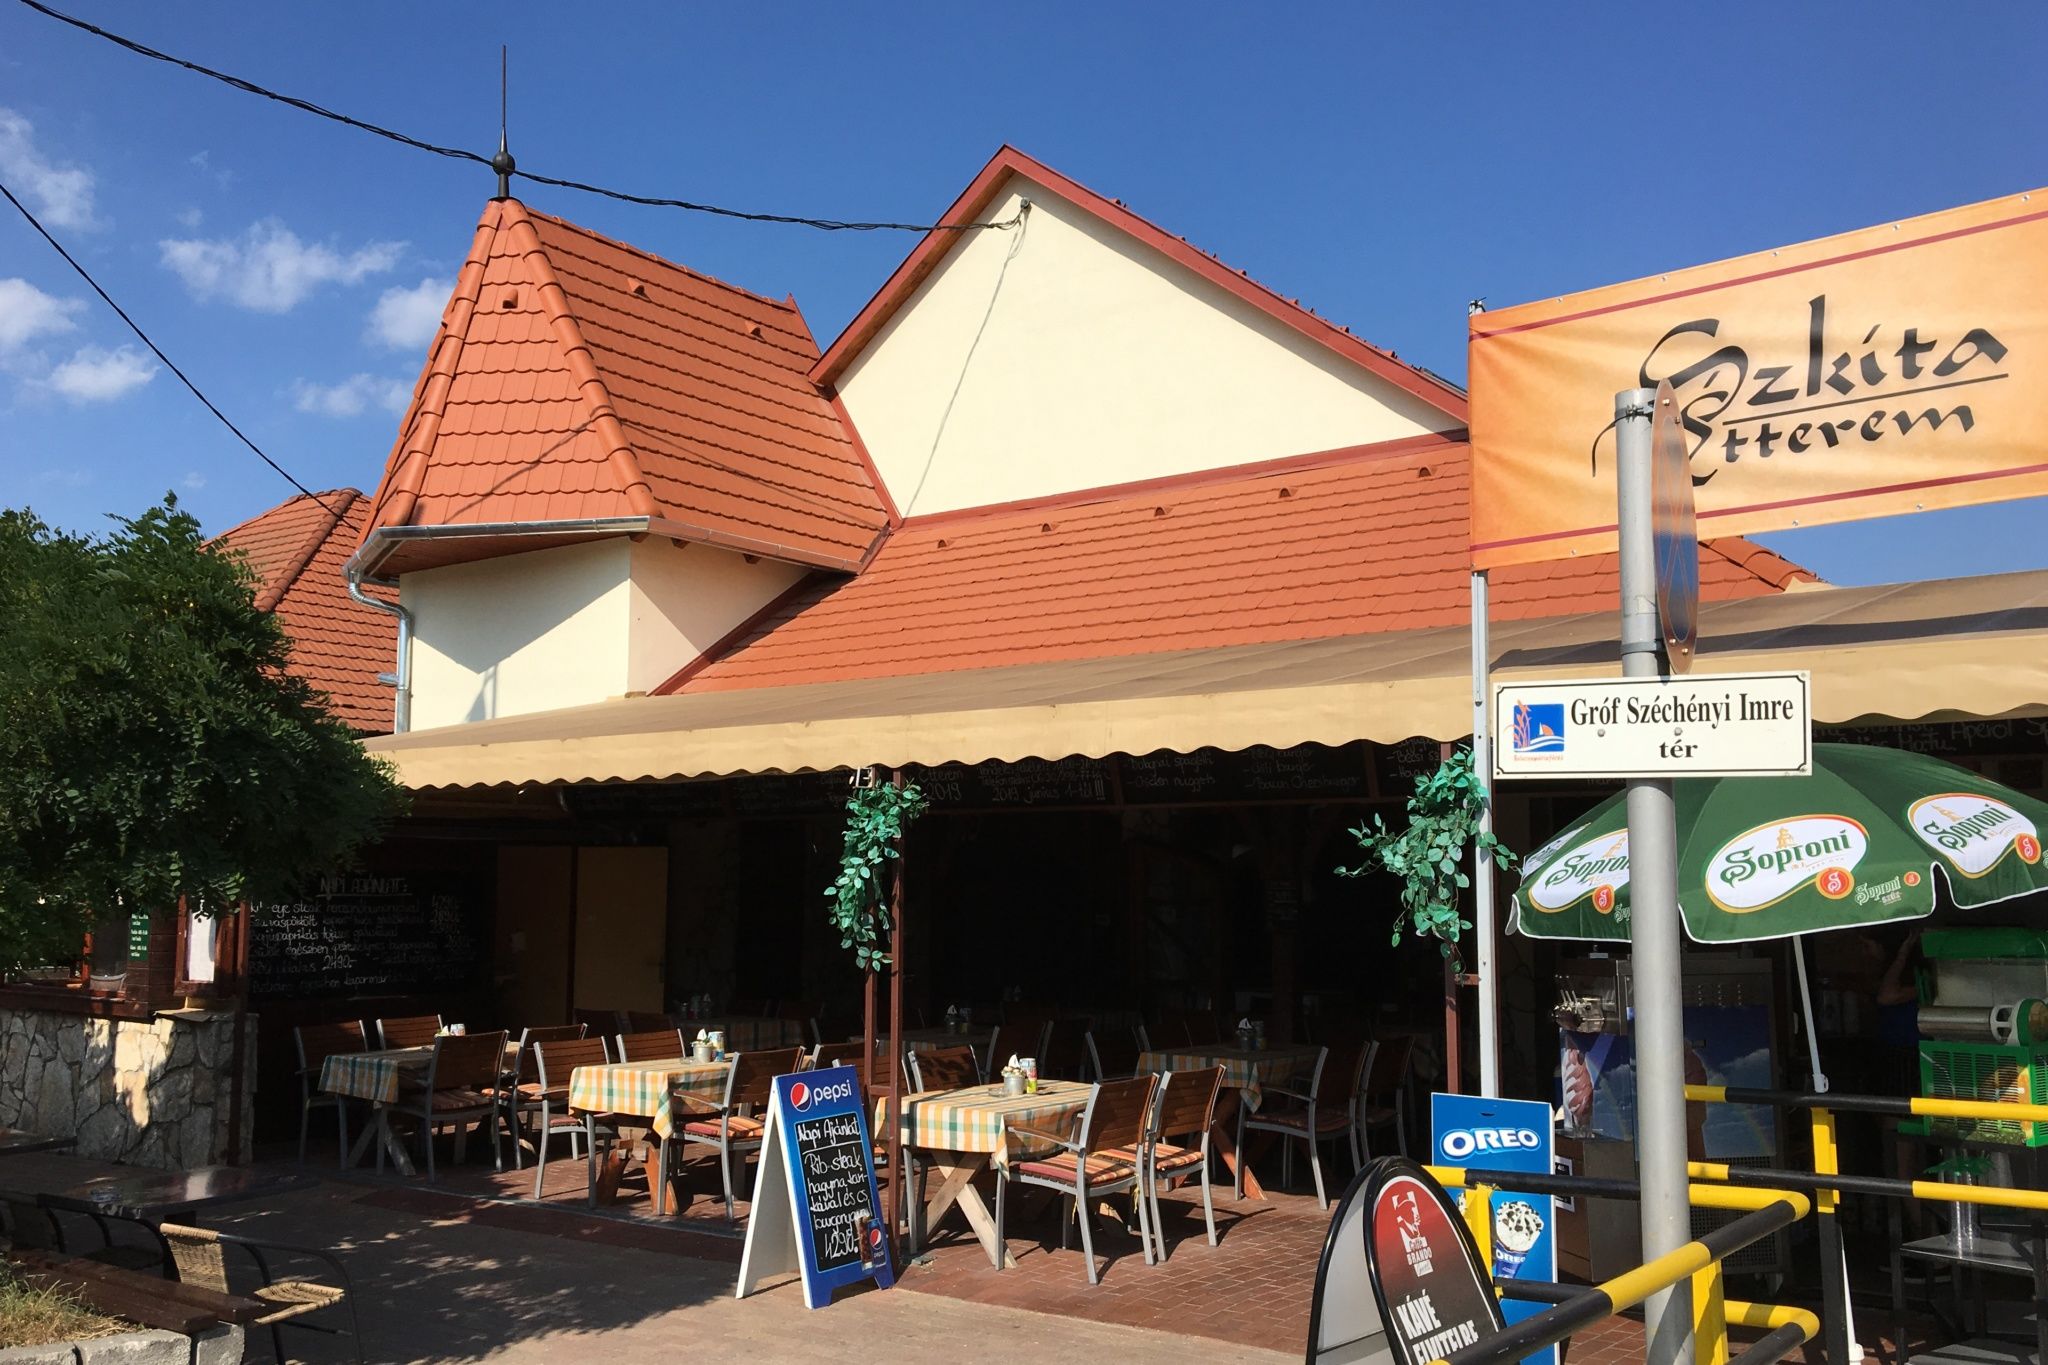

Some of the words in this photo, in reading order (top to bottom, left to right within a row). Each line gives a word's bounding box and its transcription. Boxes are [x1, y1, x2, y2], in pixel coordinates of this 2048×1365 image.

[1639, 294, 2008, 421] Szkíta
[1571, 696, 1620, 726] Gróf
[1627, 693, 1730, 729] Széchényi
[1739, 692, 1794, 721] Imre
[1659, 739, 1698, 759] tér
[1923, 804, 2012, 854] Soproni
[1544, 852, 1630, 891] Sopro
[1720, 829, 1852, 888] Soproni
[813, 1079, 852, 1106] pepsi
[797, 1122, 821, 1148] Napi
[823, 1117, 861, 1145] Ajánlat
[1442, 1128, 1540, 1159] OREO
[843, 1187, 856, 1207] és
[1406, 1246, 1433, 1266] BRANDO
[1396, 1288, 1442, 1340] KÁVÉ
